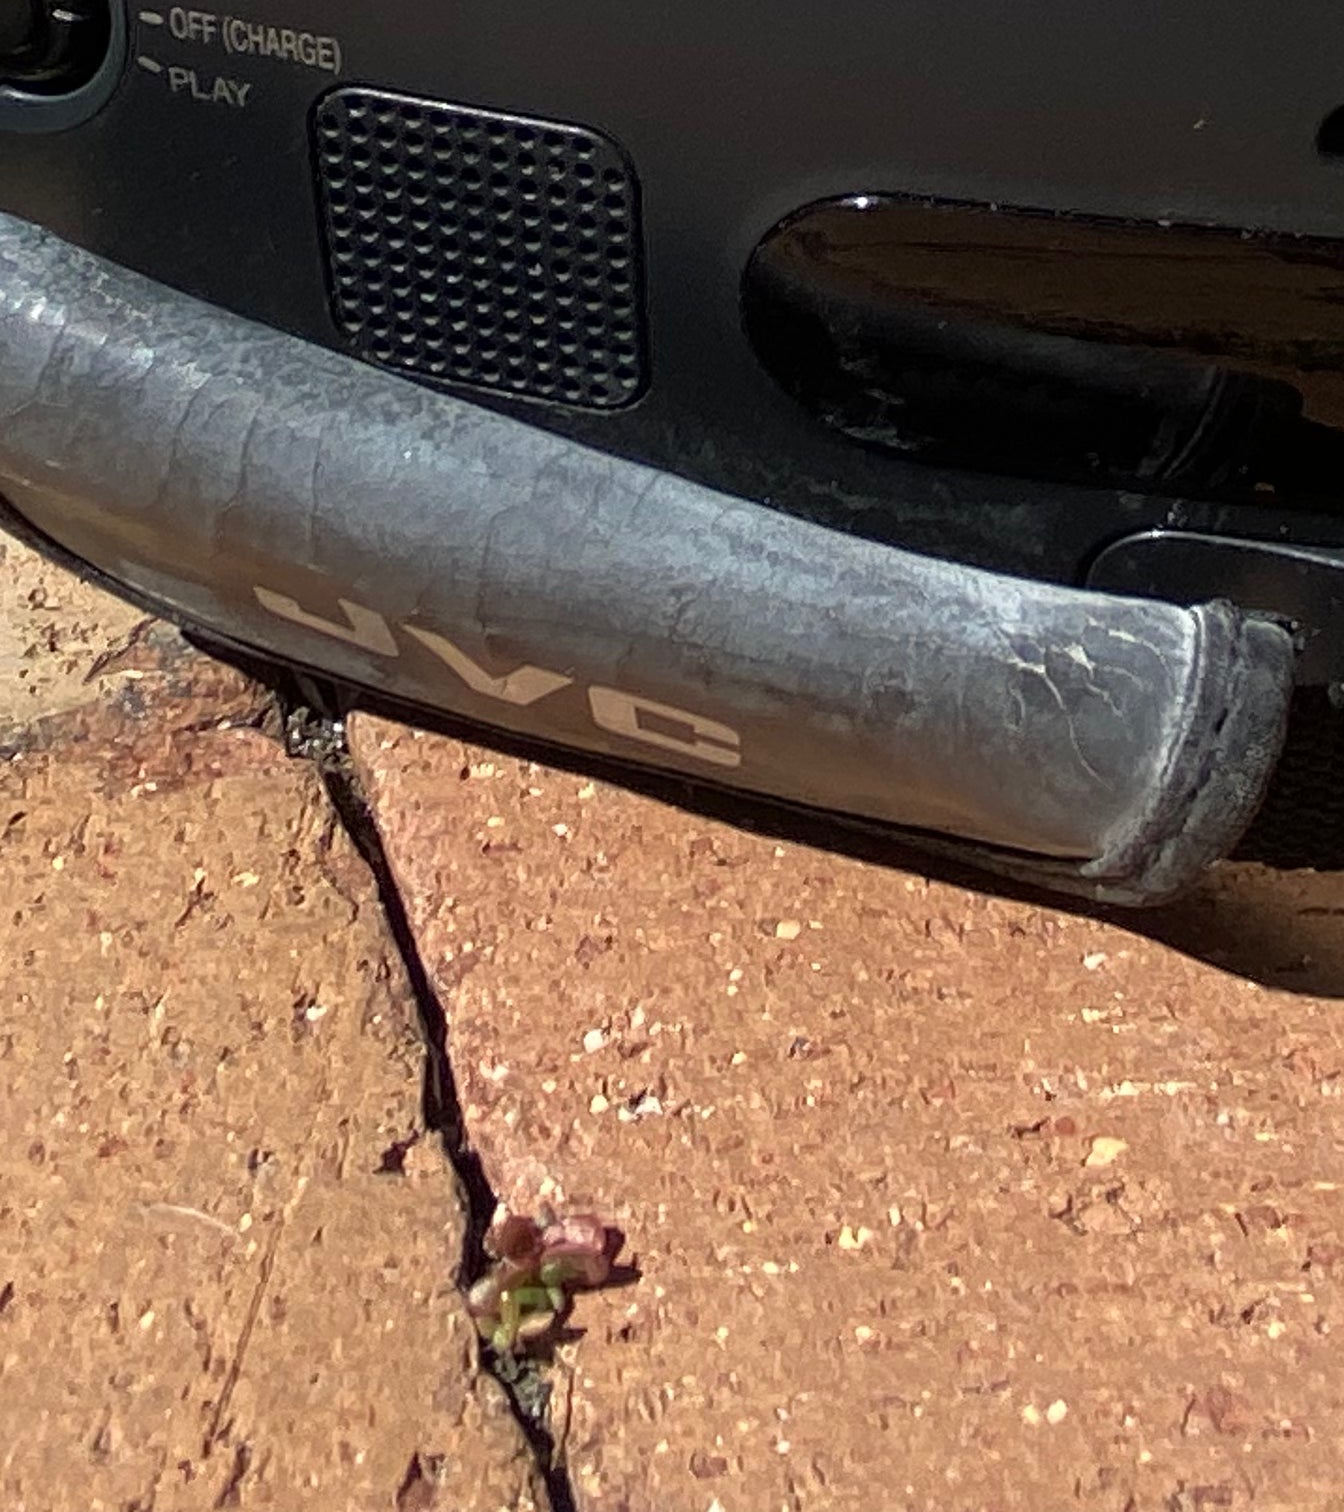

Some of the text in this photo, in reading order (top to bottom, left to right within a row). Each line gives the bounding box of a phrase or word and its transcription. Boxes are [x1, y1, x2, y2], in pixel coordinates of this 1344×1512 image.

[168, 6, 342, 75] OFF (CHARGE)
[167, 65, 252, 108] PLAY
[253, 585, 742, 768] JVC
